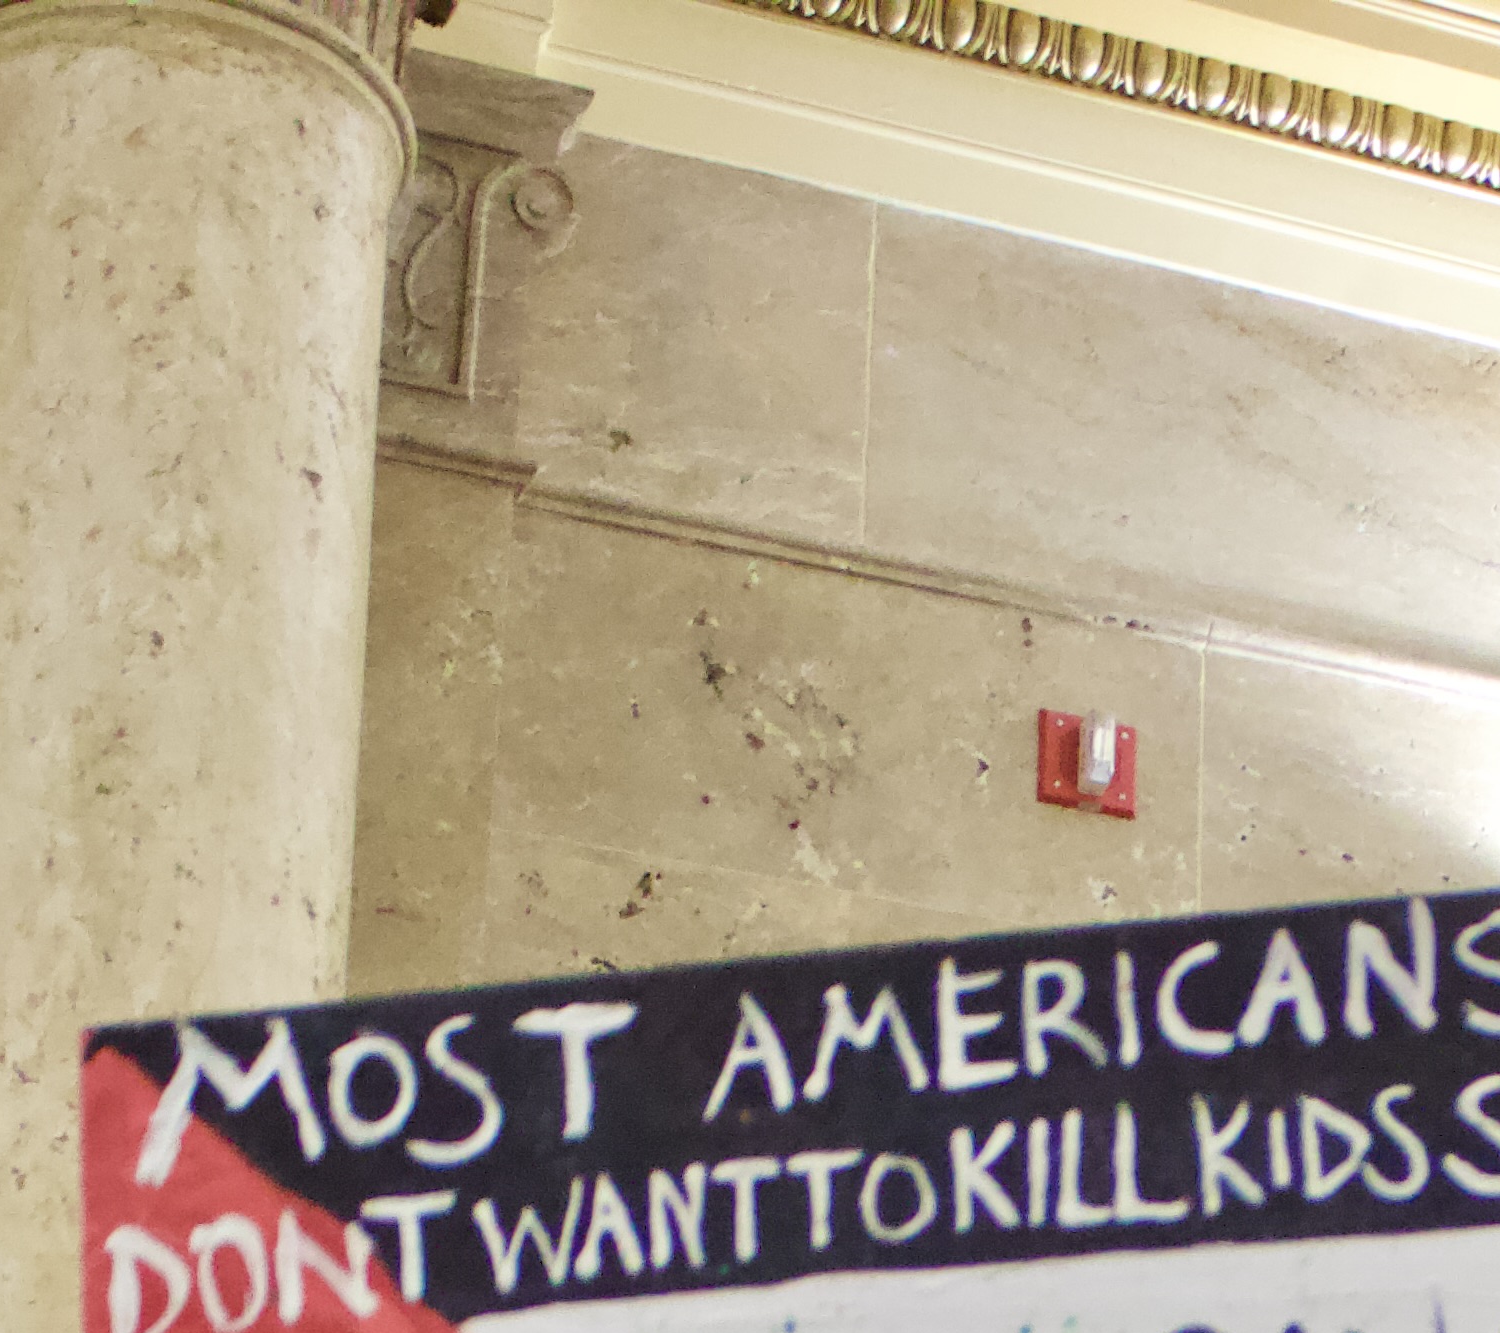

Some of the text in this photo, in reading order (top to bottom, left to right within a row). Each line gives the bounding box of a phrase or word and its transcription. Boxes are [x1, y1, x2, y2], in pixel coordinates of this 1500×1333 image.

[134, 1003, 638, 1187] MOST
[472, 1156, 781, 1295] WANT
[785, 1148, 938, 1252] TO
[949, 1100, 1191, 1234] KILL
[1192, 1083, 1430, 1217] KIDS
